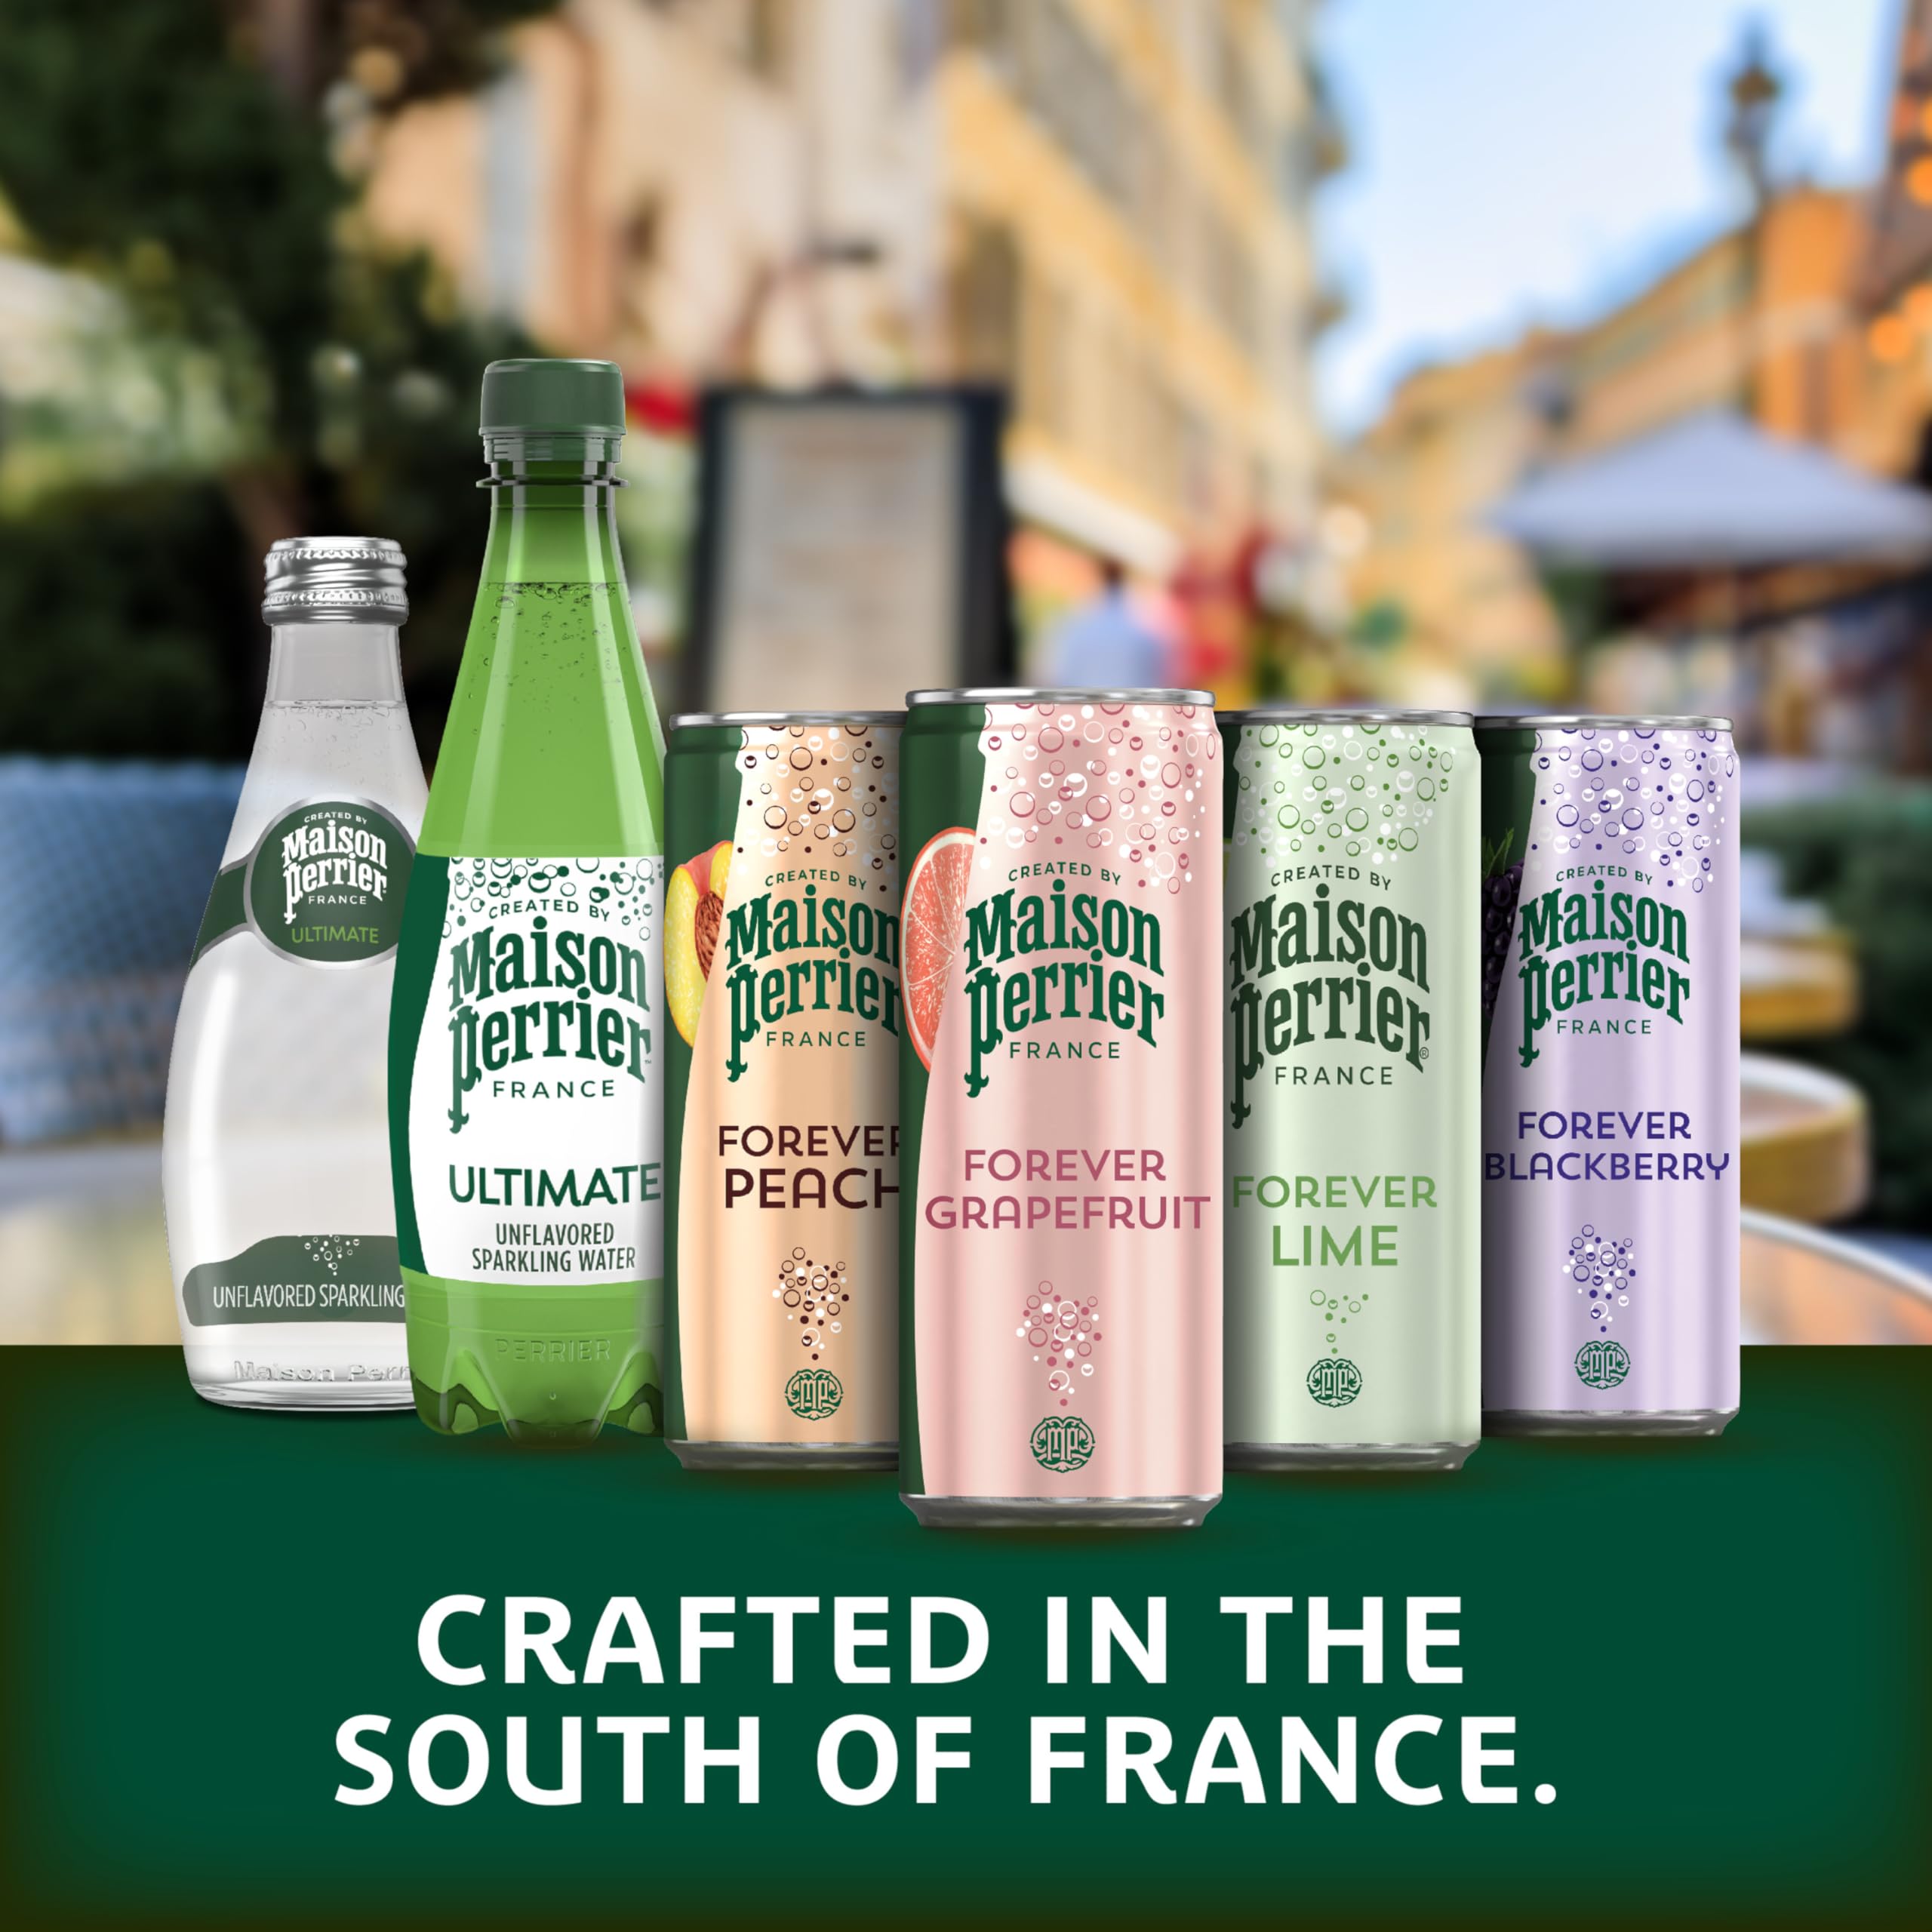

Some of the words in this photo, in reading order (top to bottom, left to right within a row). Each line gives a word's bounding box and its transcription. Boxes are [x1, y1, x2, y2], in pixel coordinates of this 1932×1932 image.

[304, 811, 352, 823] CREATED
[355, 815, 368, 825] BY
[281, 820, 388, 869] Maison
[764, 868, 840, 888] CREATED
[848, 875, 867, 890] BY
[1008, 861, 1092, 882] CREATED
[1100, 867, 1122, 886] BY
[1271, 864, 1359, 887] CREATED
[1370, 872, 1392, 891] BY
[1556, 865, 1627, 882] CREATED
[1635, 871, 1653, 886] BY
[309, 895, 368, 905] FRANCE
[489, 899, 579, 918] CREATED
[589, 906, 610, 921] BY
[291, 925, 379, 943] ULTIMATE
[724, 883, 899, 972] Maison
[964, 878, 1164, 977] Maison
[1518, 879, 1690, 964] Maison
[1230, 883, 1430, 993] Maison
[448, 915, 651, 1011] Maison
[766, 1031, 866, 1048] FRANCE
[1557, 1020, 1652, 1035] FRANCE
[1010, 1041, 1121, 1059] FRANCE
[1275, 1066, 1392, 1085] FRANCE
[494, 1079, 614, 1098] FRANCE
[1518, 1111, 1691, 1140] FOREVER
[964, 1149, 1166, 1182] FOREVER
[1484, 1152, 1730, 1181] BLACKBERRY
[449, 1162, 662, 1207] ULTIMATE
[724, 1168, 899, 1208] PEACH
[1233, 1175, 1438, 1208] FOREVER
[925, 1195, 1211, 1229] GRAPEFRUIT
[495, 1223, 614, 1245] UNFLAVORED
[1272, 1224, 1398, 1266] LIME
[472, 1248, 571, 1272] SPARKLING
[579, 1247, 635, 1269] WATER
[213, 1284, 315, 1308] UNFLAVORED
[319, 1284, 405, 1308] SPARKLING
[495, 1338, 611, 1362] PERRIER
[234, 1360, 335, 1381] Maison
